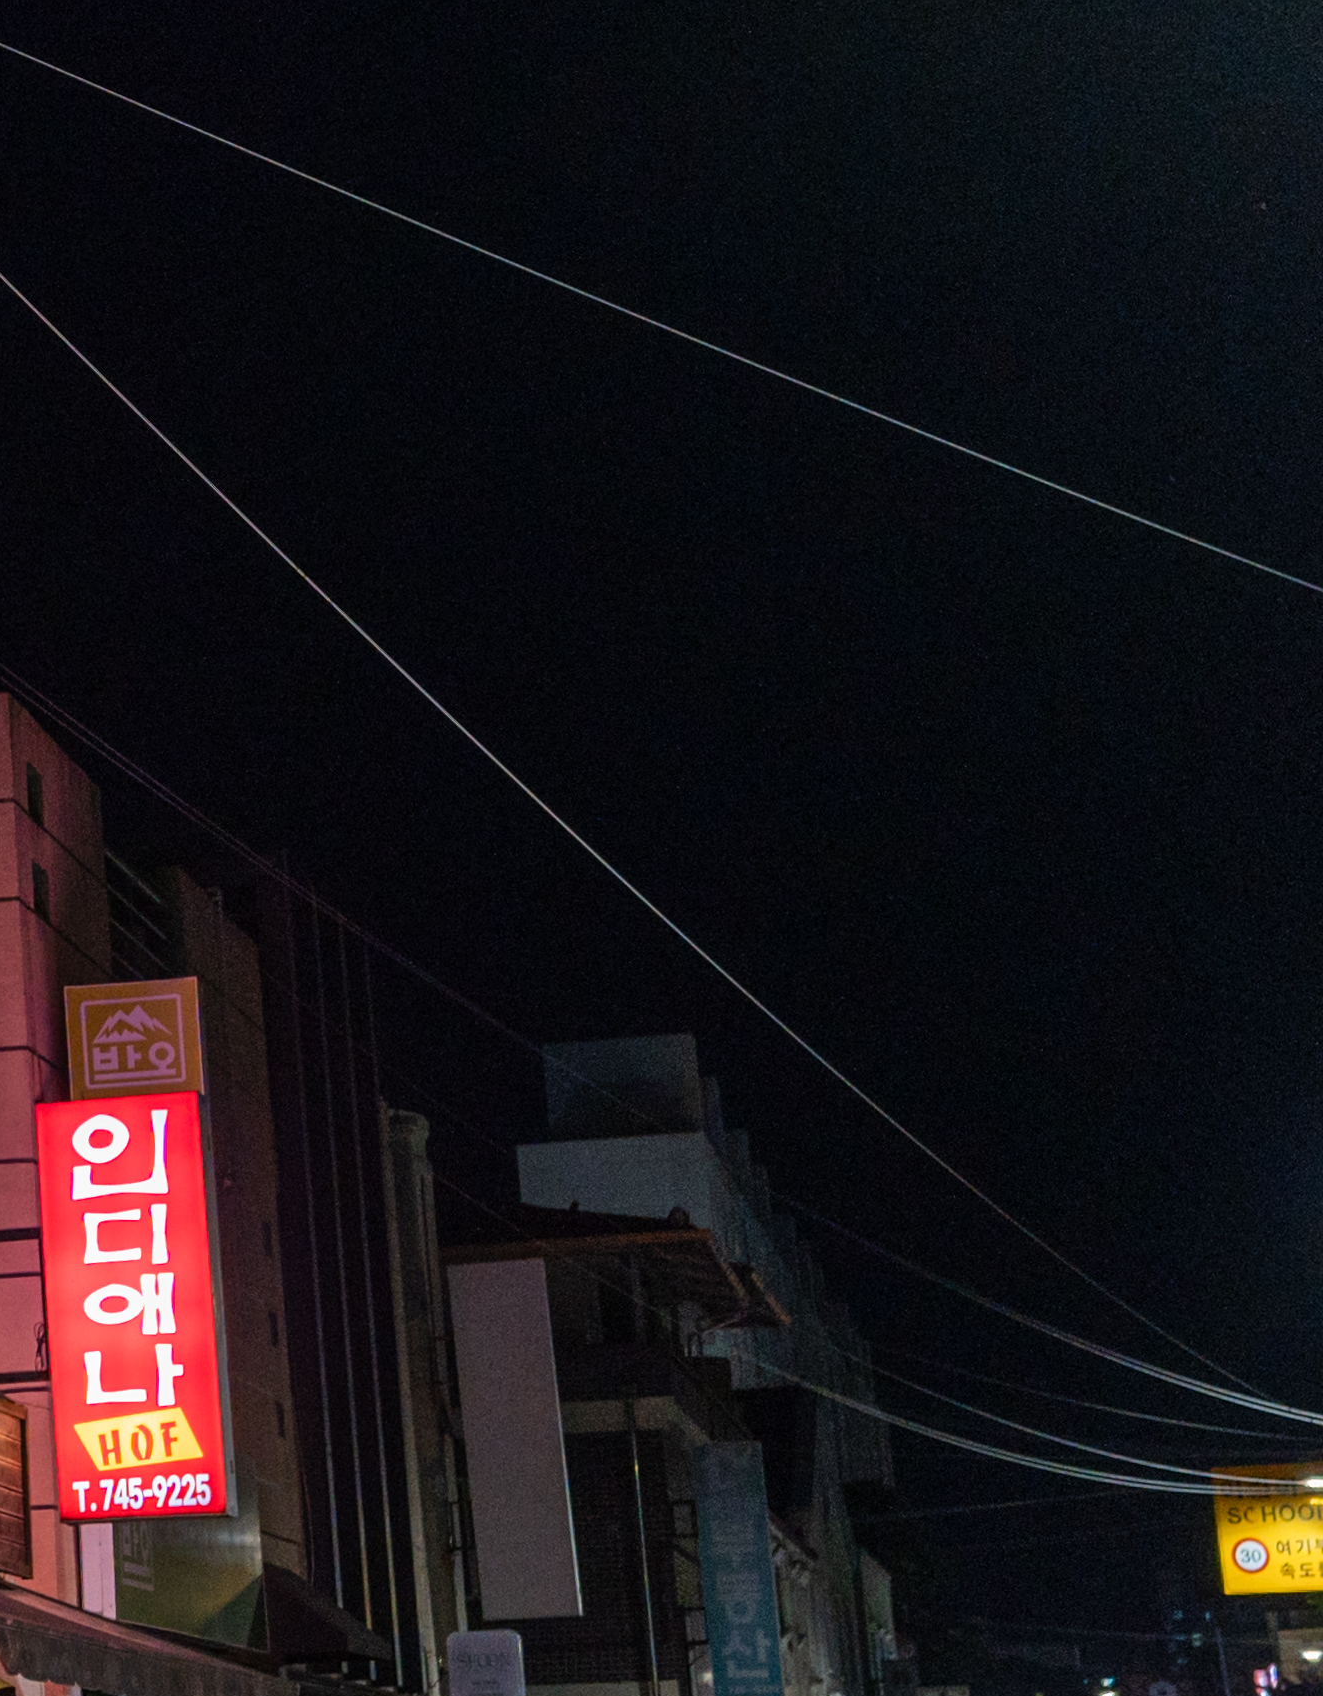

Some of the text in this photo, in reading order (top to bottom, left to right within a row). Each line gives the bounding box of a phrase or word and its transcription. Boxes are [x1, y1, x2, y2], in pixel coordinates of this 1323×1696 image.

[72, 1109, 184, 1406] 인디애나
[98, 1421, 178, 1467] HOF
[1240, 1548, 1262, 1564] 30
